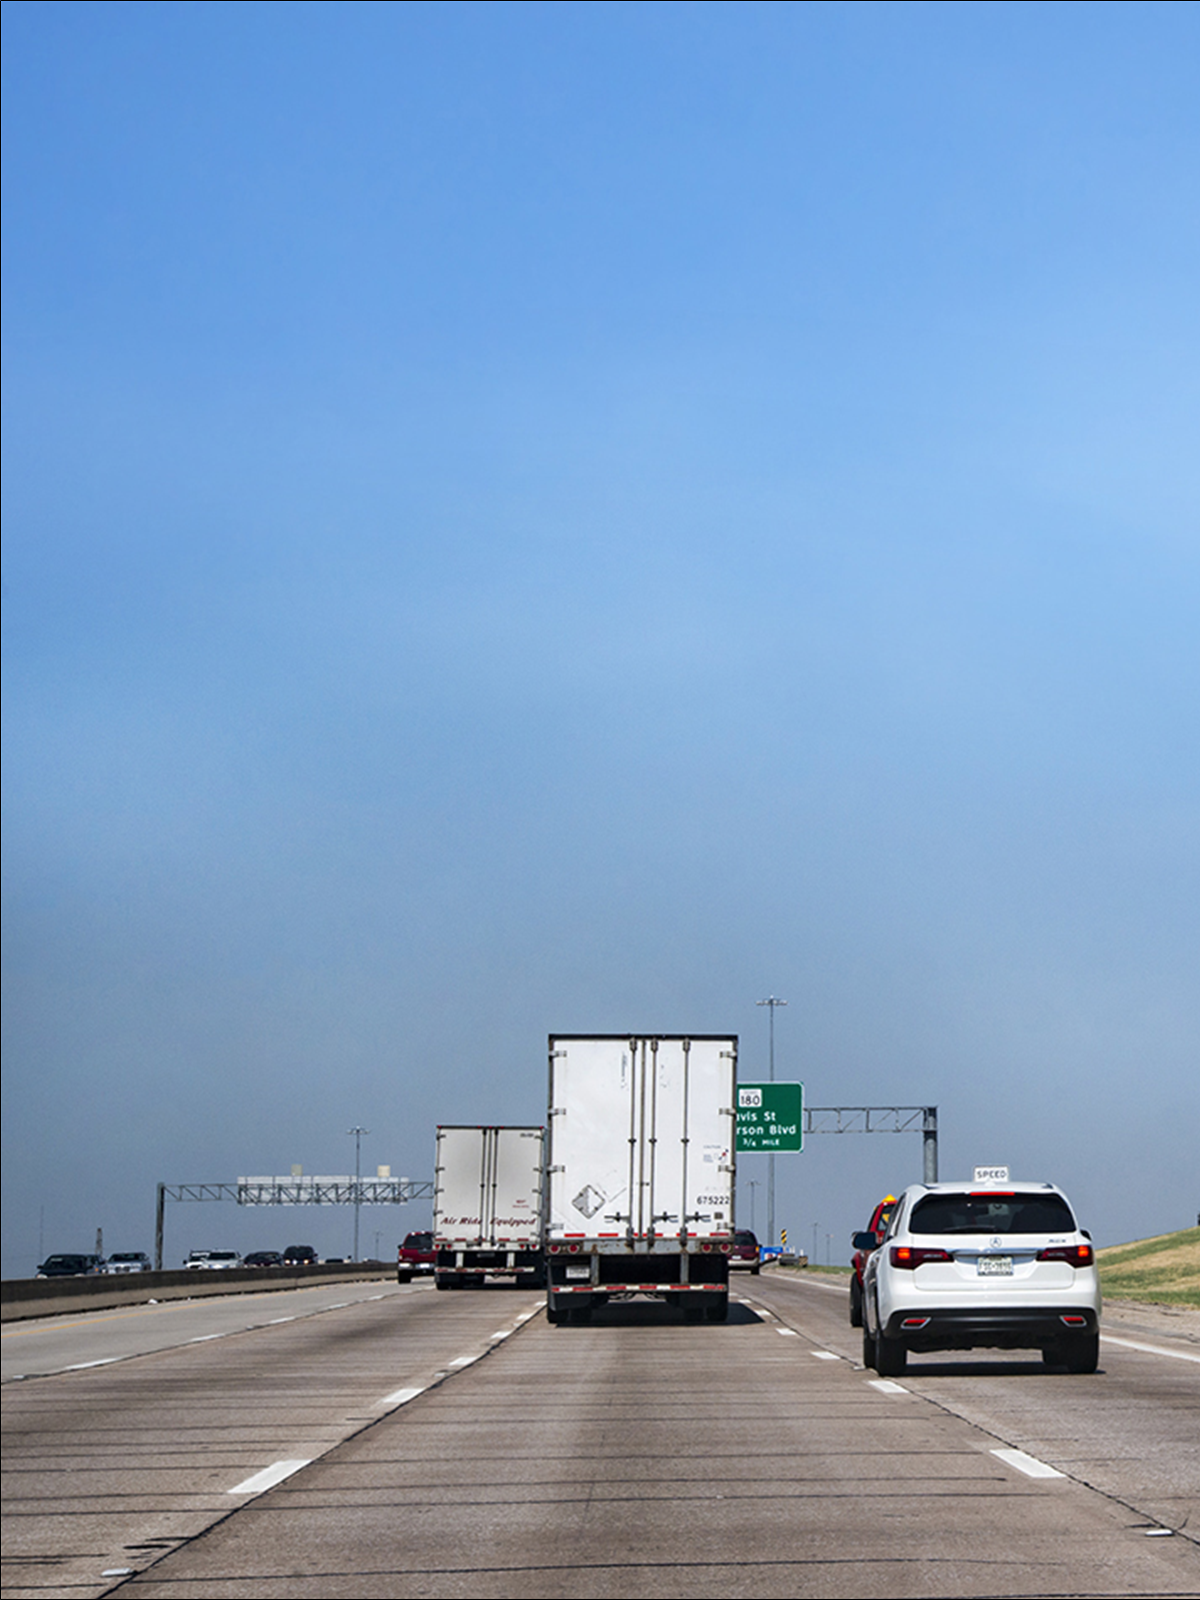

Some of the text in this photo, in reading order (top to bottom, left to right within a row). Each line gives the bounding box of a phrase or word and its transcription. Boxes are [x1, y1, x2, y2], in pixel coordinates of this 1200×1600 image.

[740, 1095, 760, 1106] 180
[763, 1111, 777, 1122] St
[769, 1124, 797, 1136] Blvd
[976, 1169, 1008, 1179] SPEED
[696, 1195, 731, 1205] 675222
[441, 1217, 458, 1225] Air
[489, 1217, 537, 1227] Equipped
